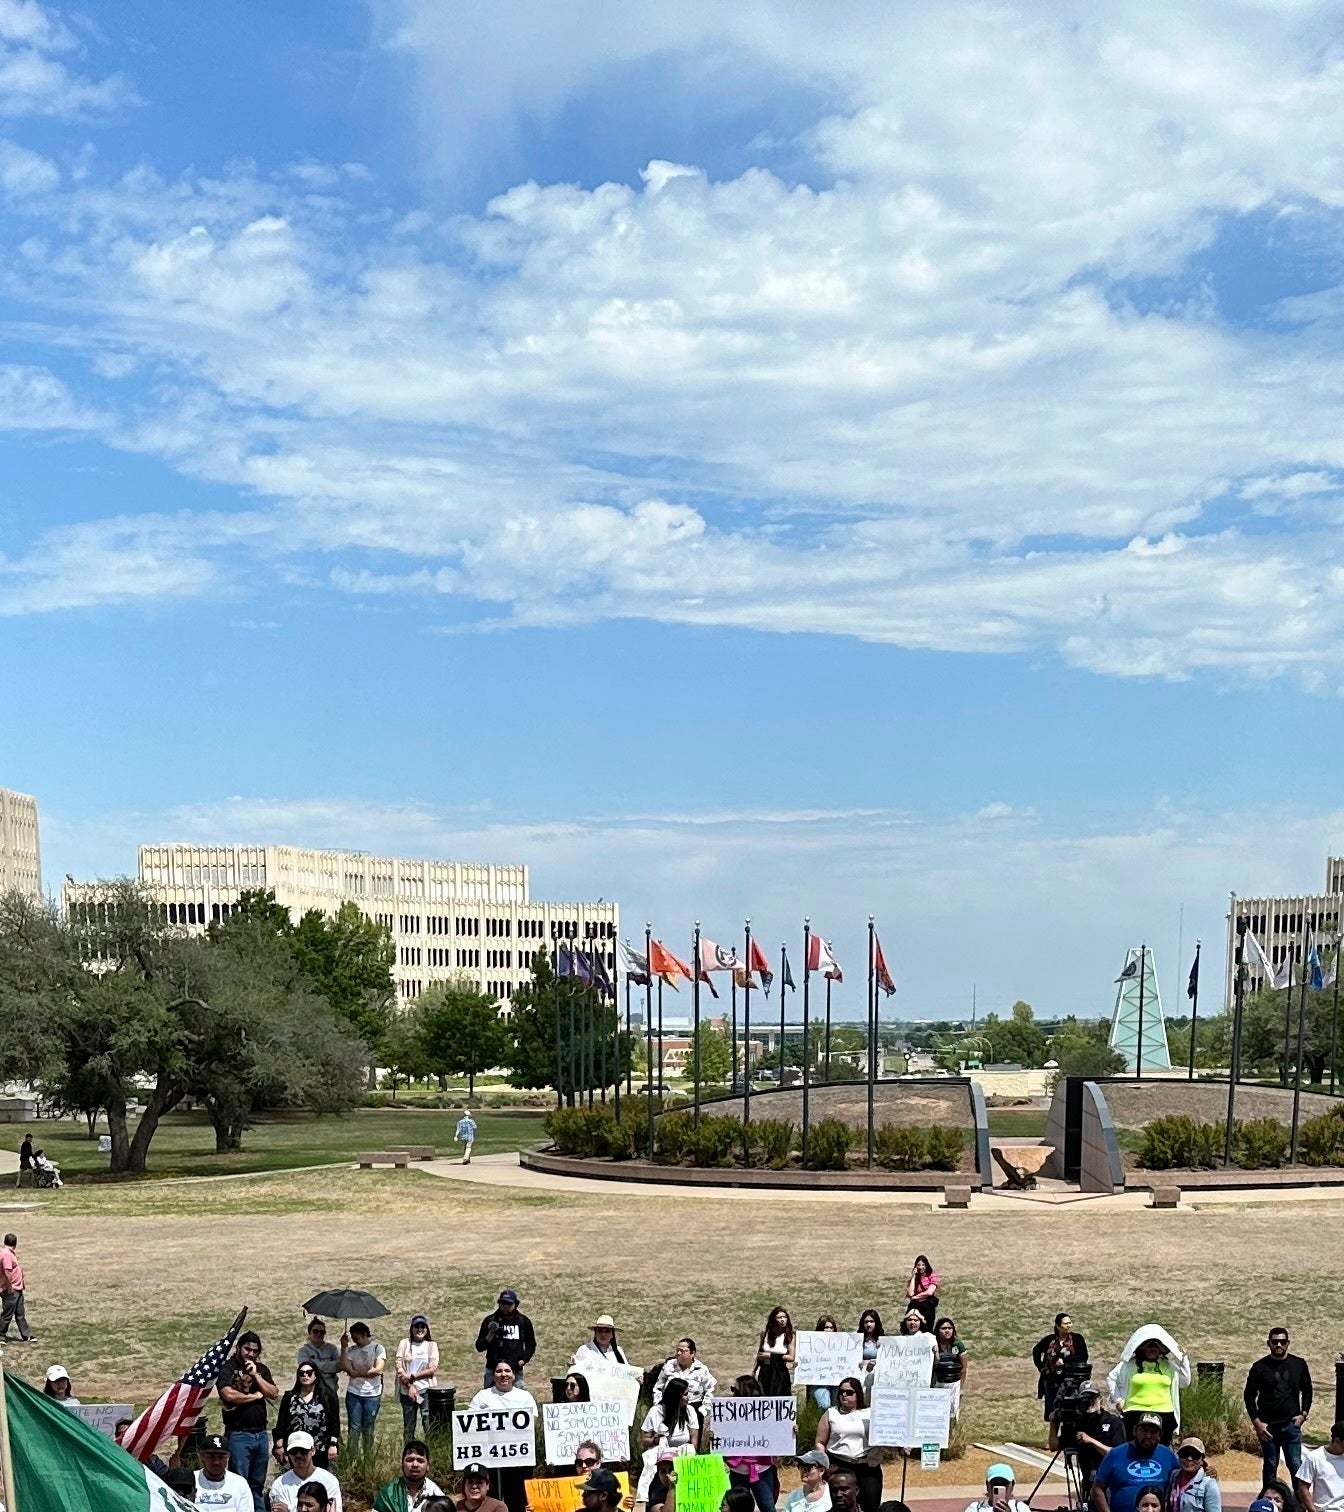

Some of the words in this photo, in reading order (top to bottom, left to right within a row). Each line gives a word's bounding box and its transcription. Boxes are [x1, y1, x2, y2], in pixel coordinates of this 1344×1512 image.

[96, 1406, 113, 1415] NO
[712, 1399, 796, 1423] #STOPHB4156
[456, 1410, 530, 1433] VETO
[456, 1446, 483, 1460] HB
[489, 1443, 529, 1458] 4156
